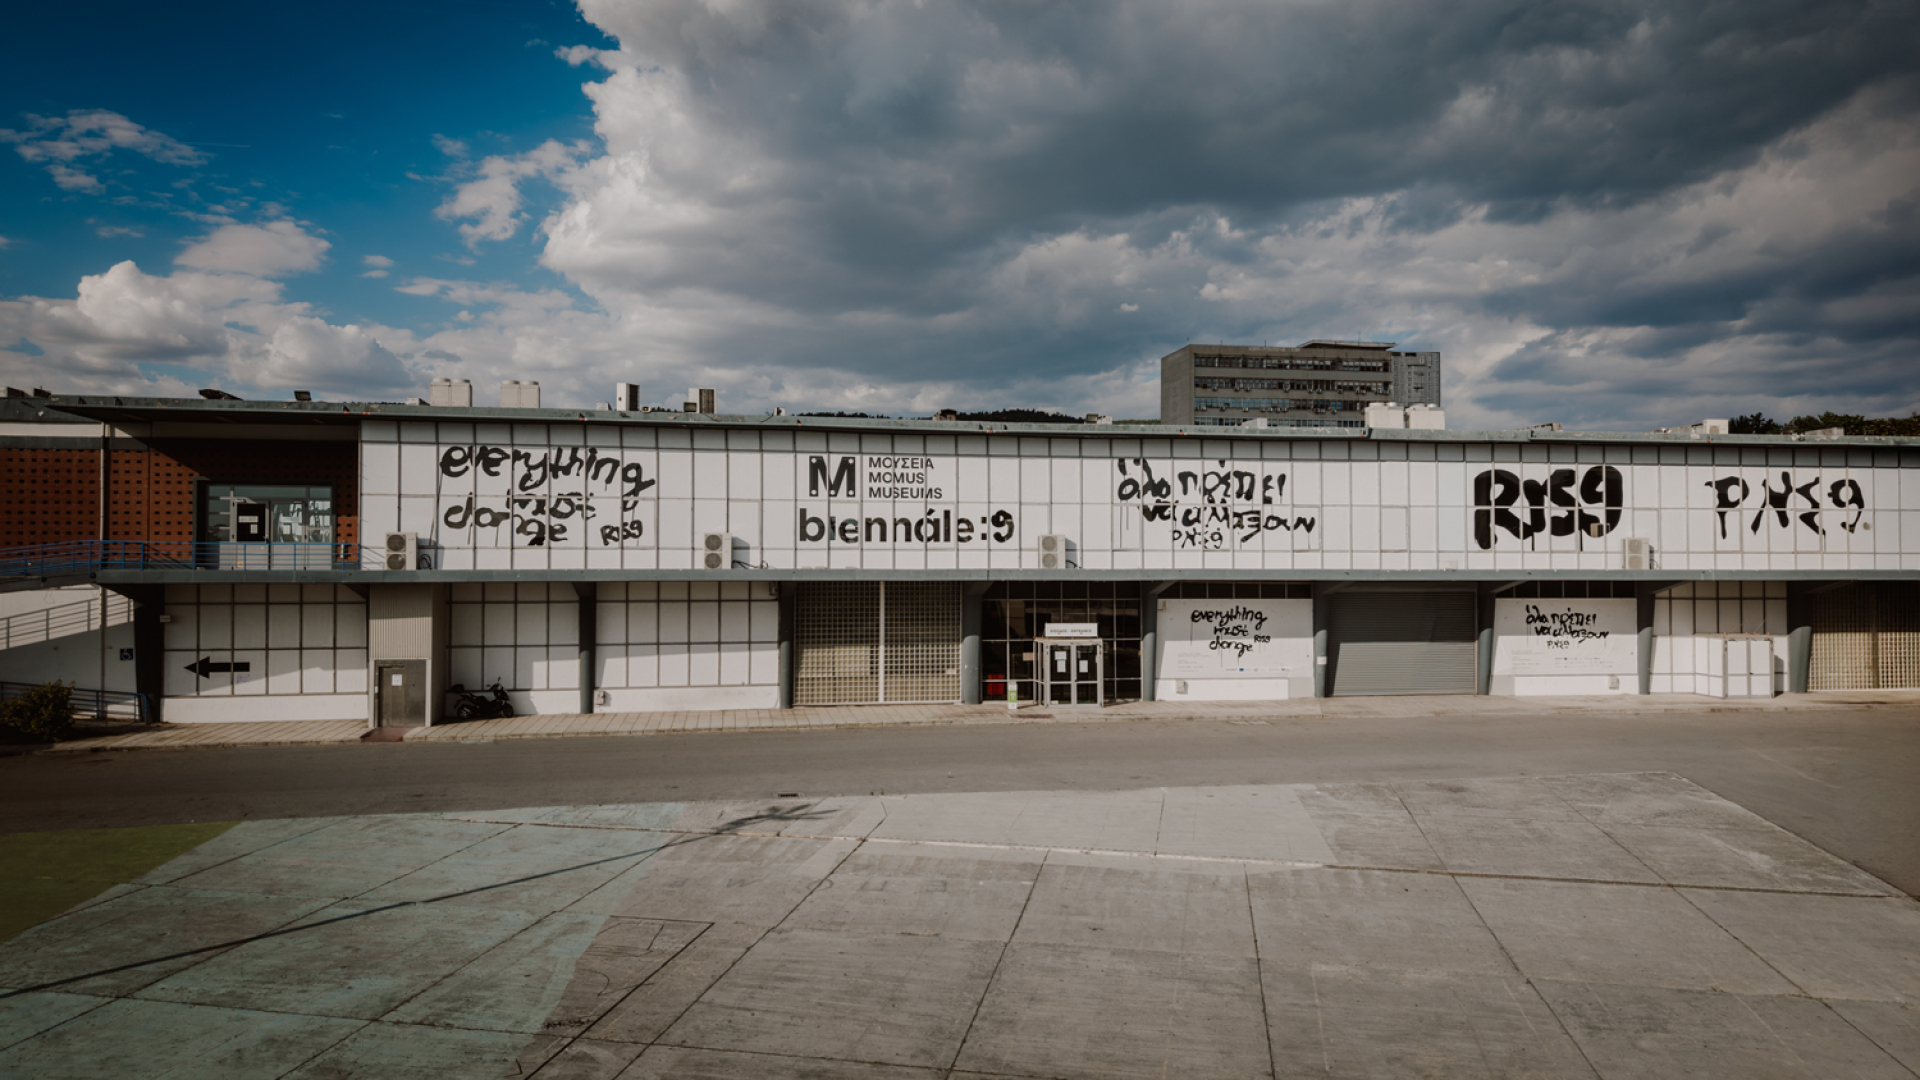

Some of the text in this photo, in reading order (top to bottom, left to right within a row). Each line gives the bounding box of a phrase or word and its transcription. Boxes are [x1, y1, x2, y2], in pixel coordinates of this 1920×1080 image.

[868, 456, 934, 470] ΜΟΥΣΕΙΑ
[440, 446, 655, 512] everything
[809, 455, 856, 497] M
[868, 471, 925, 485] MOMUS
[868, 486, 943, 499] MUSEUMS
[1191, 605, 1268, 630] everything
[1209, 635, 1253, 658] change
